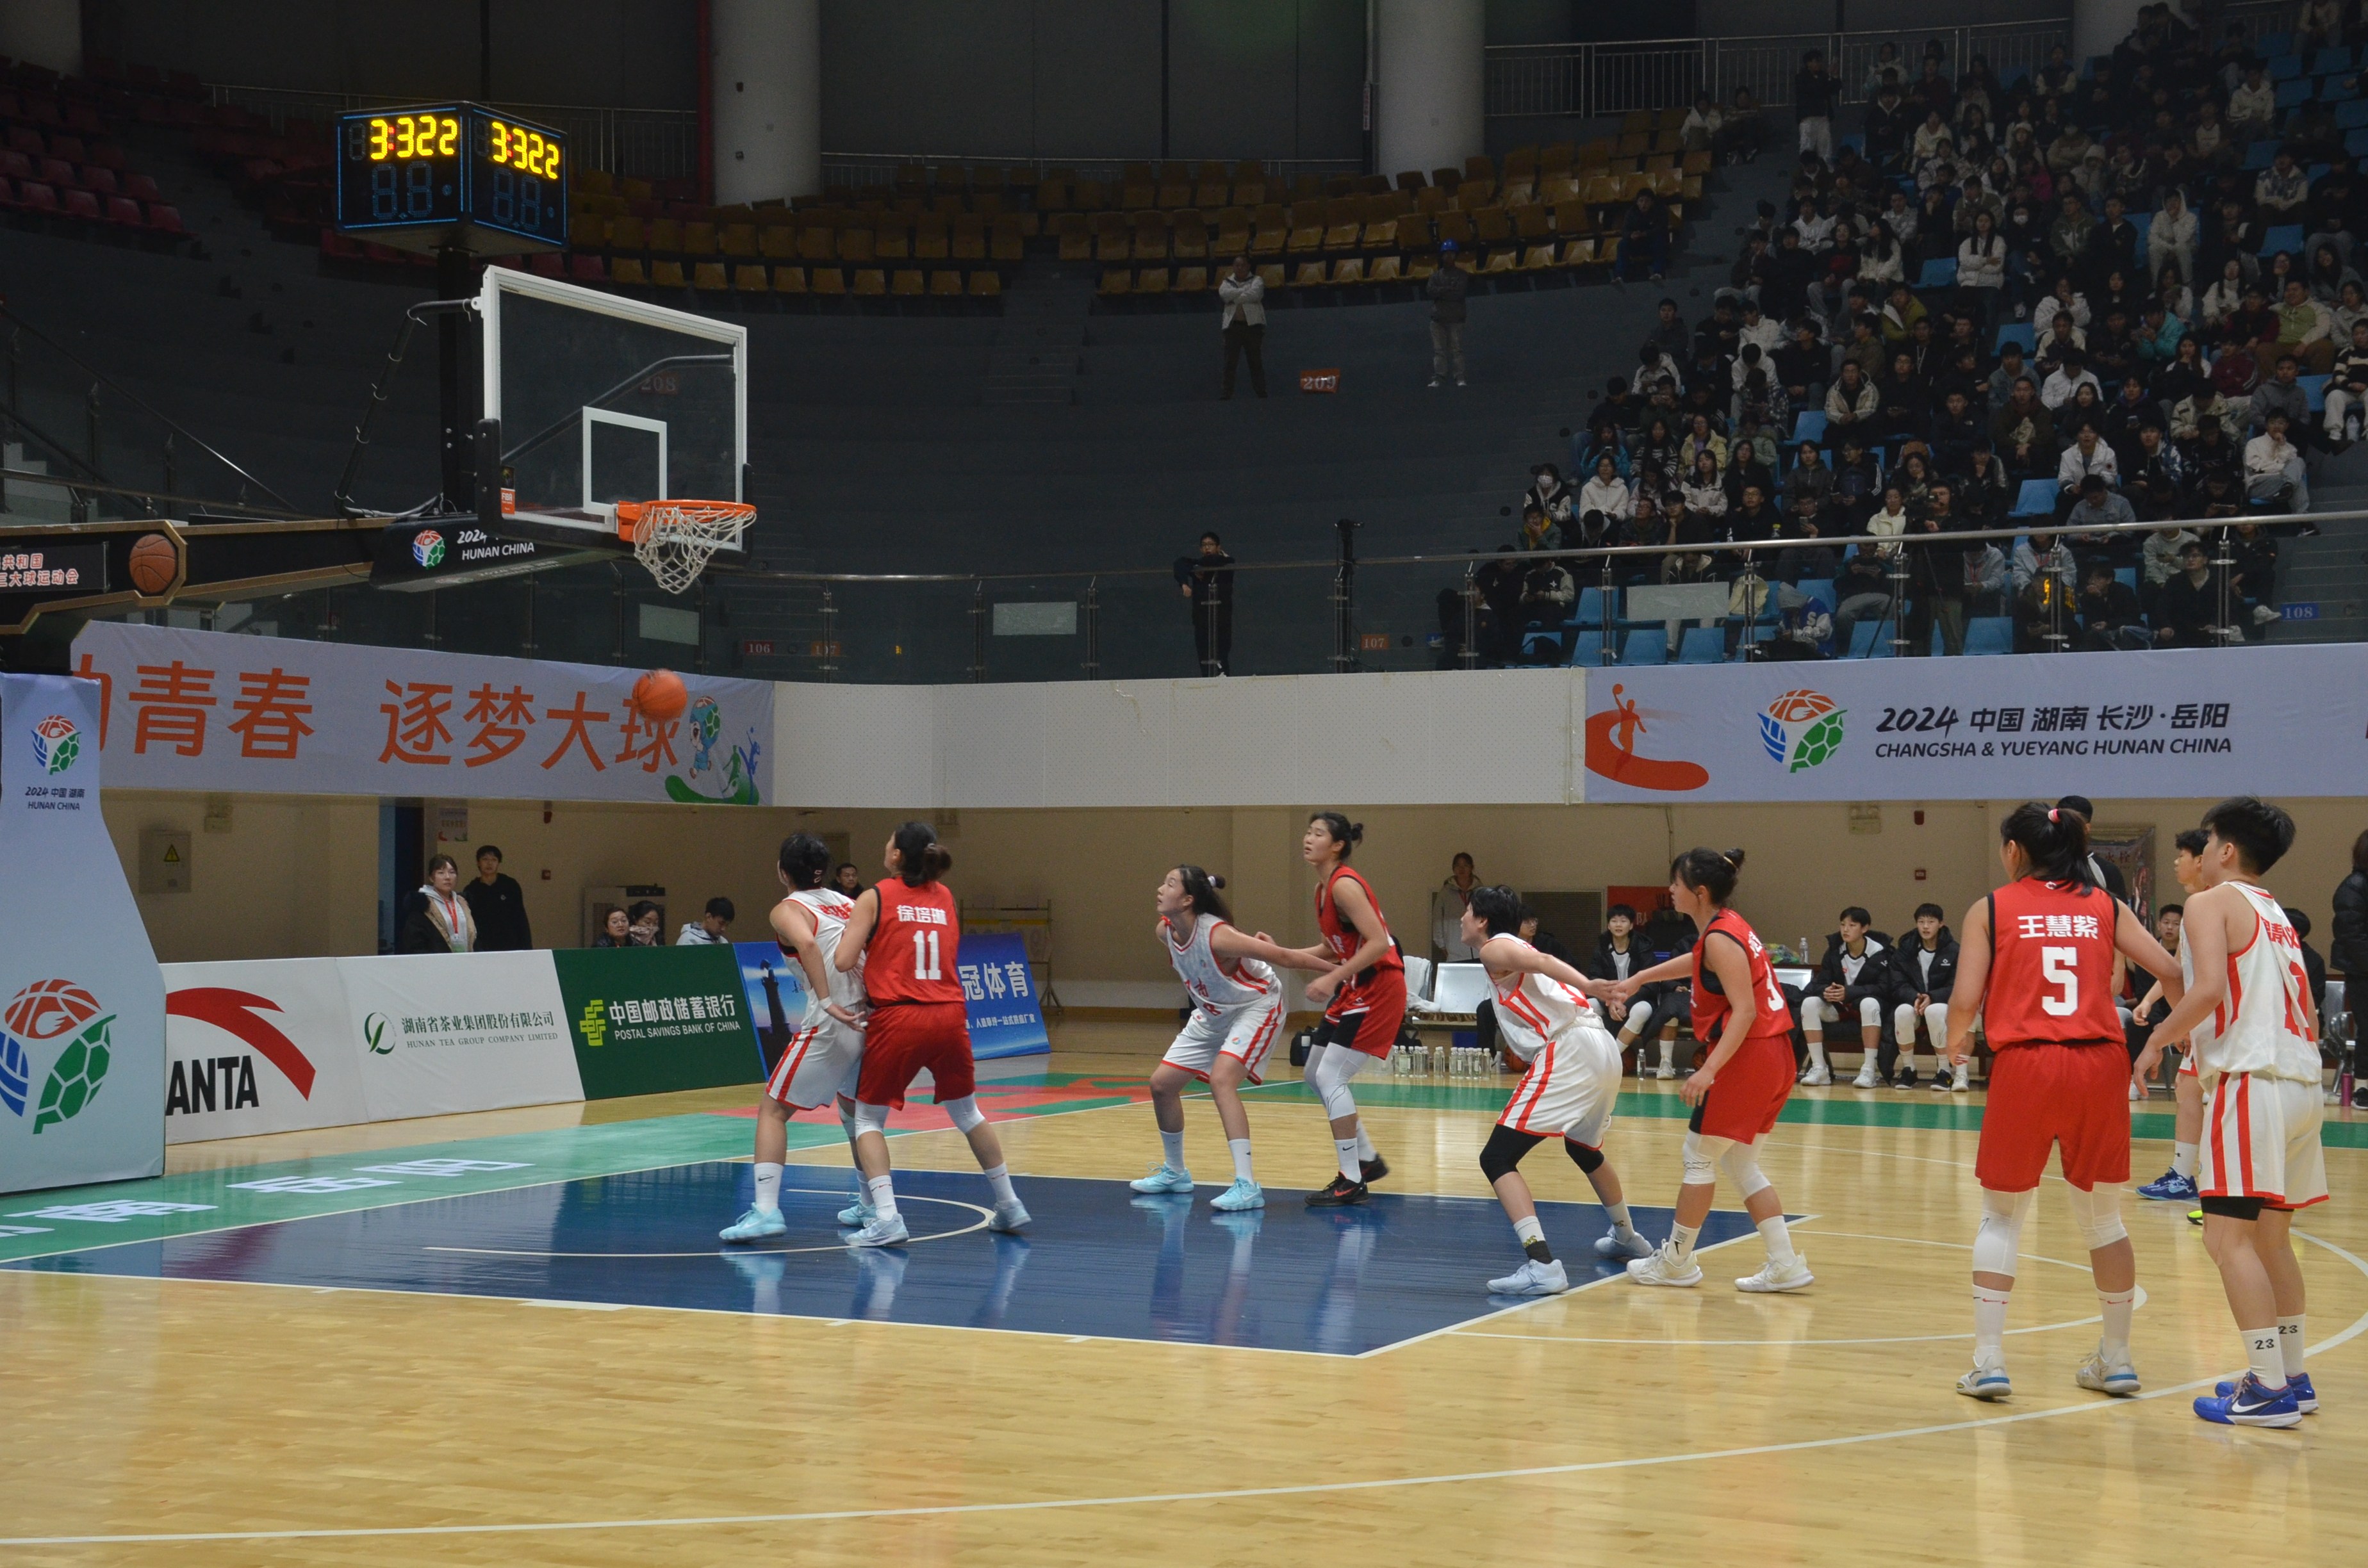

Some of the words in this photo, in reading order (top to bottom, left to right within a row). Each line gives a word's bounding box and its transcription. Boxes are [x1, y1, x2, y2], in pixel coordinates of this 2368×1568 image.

[1303, 375, 1336, 390] 209
[461, 546, 500, 560] HUNAN
[502, 542, 534, 556] CHINA
[0, 553, 43, 570] 共和国
[2285, 607, 2313, 619] 108
[748, 643, 771, 653] 106
[1364, 638, 1385, 648] 107
[379, 678, 680, 774] 逐梦大球
[1876, 706, 1959, 738] 2024
[1970, 707, 2025, 733] 中国
[2030, 706, 2089, 731] 湖南
[1875, 742, 1977, 758] CHANGSHA
[1981, 742, 1994, 756] &
[2001, 740, 2088, 756] YUEYANG
[2093, 739, 2165, 755] HUNAN
[2169, 737, 2232, 754] CHINA
[24, 787, 49, 799] 2024
[51, 787, 67, 798] 中国
[69, 787, 85, 799] 湖南
[28, 801, 55, 810] HUNAN
[57, 801, 80, 810] CHINA
[2018, 915, 2098, 940] 王慧紫
[913, 930, 942, 980] 11
[958, 961, 1029, 1001] 冠体育
[2042, 946, 2078, 1017] 5
[609, 994, 736, 1026] 中国邮政储蓄银行
[401, 1011, 555, 1034] 湖南省茶业集团股份有限公司
[614, 1029, 646, 1040] POSTAL
[646, 1025, 681, 1038] SAVINGS
[682, 1024, 703, 1035] BANK
[705, 1022, 715, 1033] OF
[717, 1021, 741, 1032] CHINA
[407, 1040, 436, 1049] HUNAN
[439, 1038, 455, 1047] TEA
[458, 1037, 485, 1045] GROUP
[488, 1034, 525, 1043] COMPANY
[528, 1033, 558, 1041] LIMITED
[165, 1055, 259, 1116] ANTA
[2278, 1325, 2298, 1335] 23
[2255, 1338, 2274, 1350] 23
